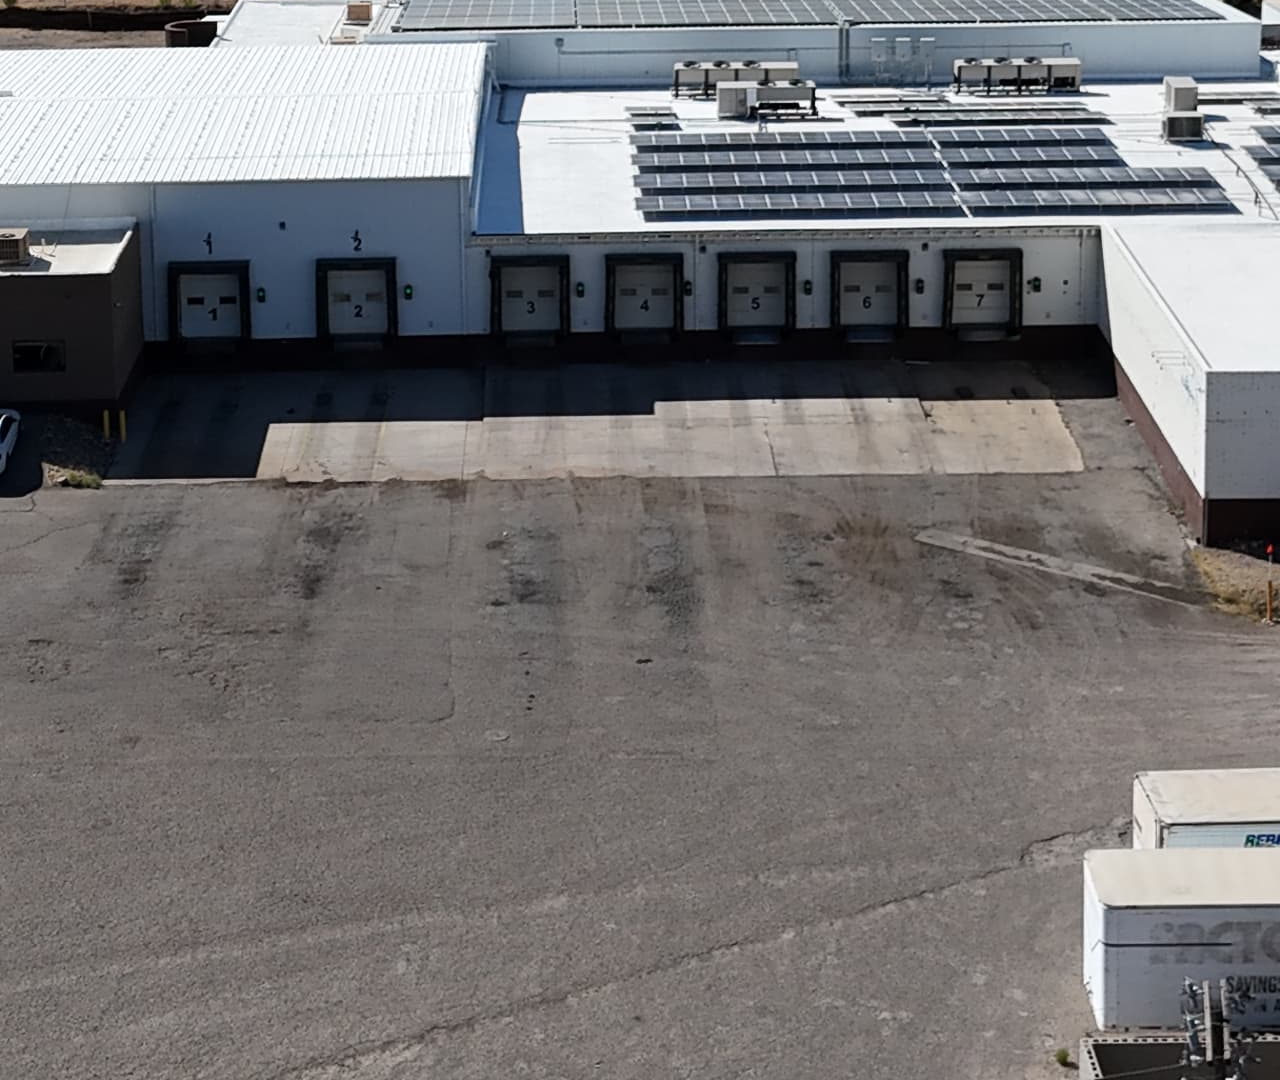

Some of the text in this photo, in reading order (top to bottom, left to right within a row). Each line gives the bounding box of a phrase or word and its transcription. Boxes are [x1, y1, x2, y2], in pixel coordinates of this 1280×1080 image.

[526, 300, 536, 314] 3
[640, 299, 650, 312] 4
[751, 296, 761, 310] 5
[862, 295, 872, 309] 6
[975, 294, 985, 307] 7
[208, 307, 218, 321] 1
[354, 304, 363, 318] 2
